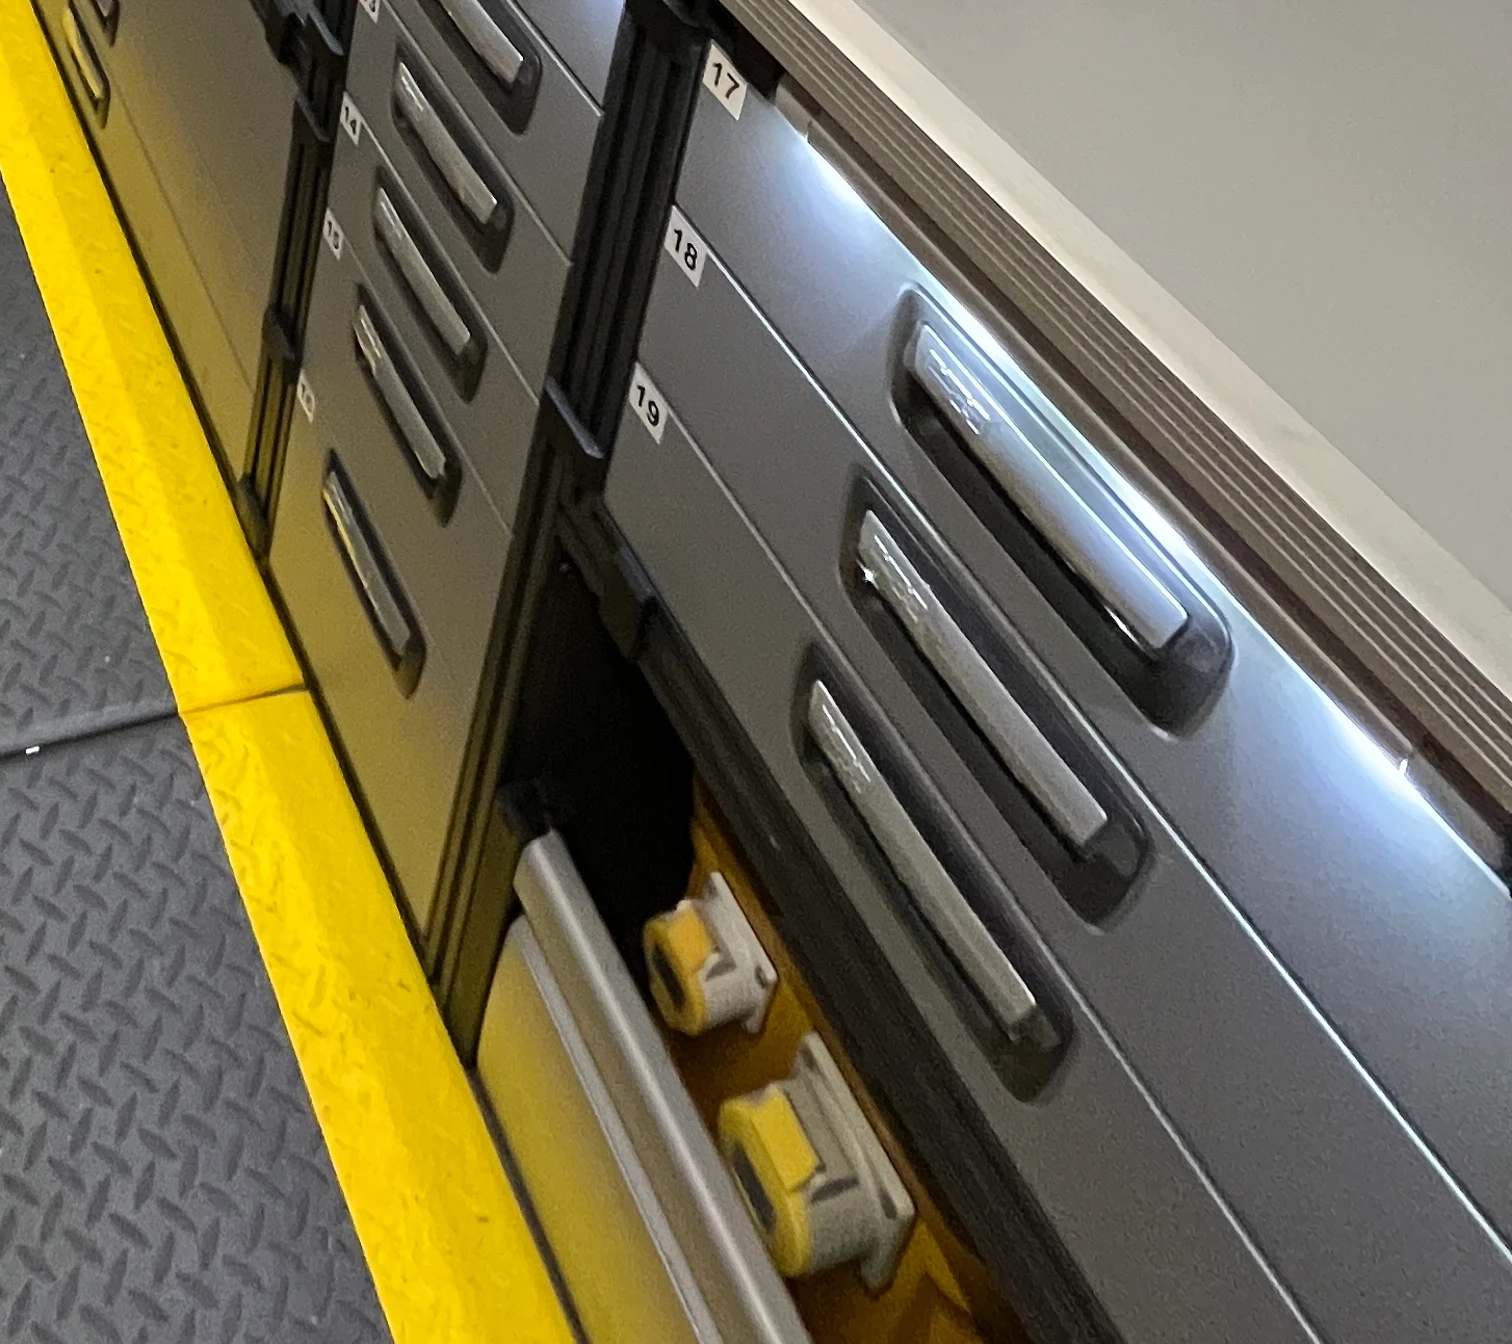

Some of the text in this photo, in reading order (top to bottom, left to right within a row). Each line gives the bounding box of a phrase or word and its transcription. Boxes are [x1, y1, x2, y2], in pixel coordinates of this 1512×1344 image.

[711, 61, 741, 101] 17
[343, 105, 358, 136] 14
[672, 228, 700, 272] 18
[636, 385, 661, 429] 19
